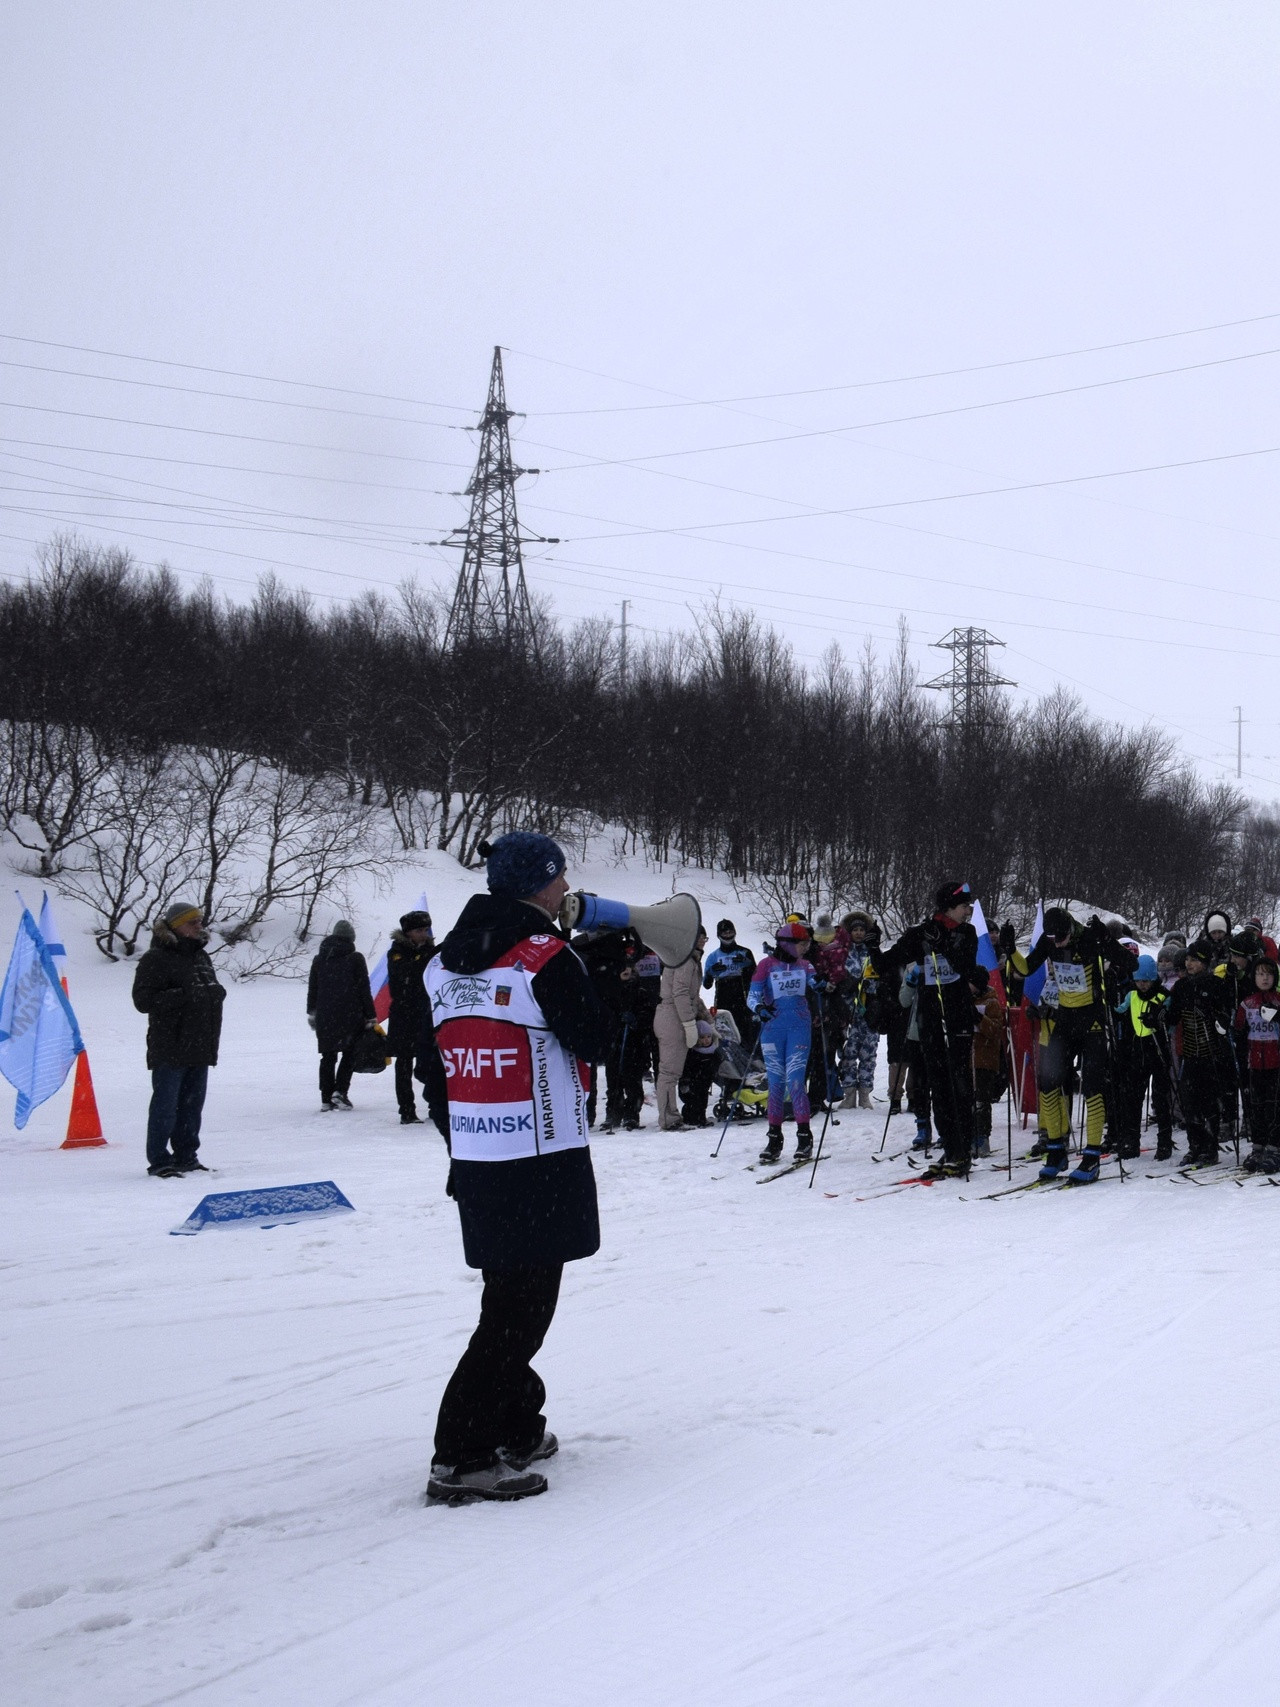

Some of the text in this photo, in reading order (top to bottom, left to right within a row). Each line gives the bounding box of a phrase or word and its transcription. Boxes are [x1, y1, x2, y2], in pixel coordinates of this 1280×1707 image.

[778, 979, 801, 991] 2455
[1250, 1021, 1274, 1033] 2456
[444, 1047, 518, 1078] STAFF
[536, 1037, 555, 1141] MARATHON51.RU
